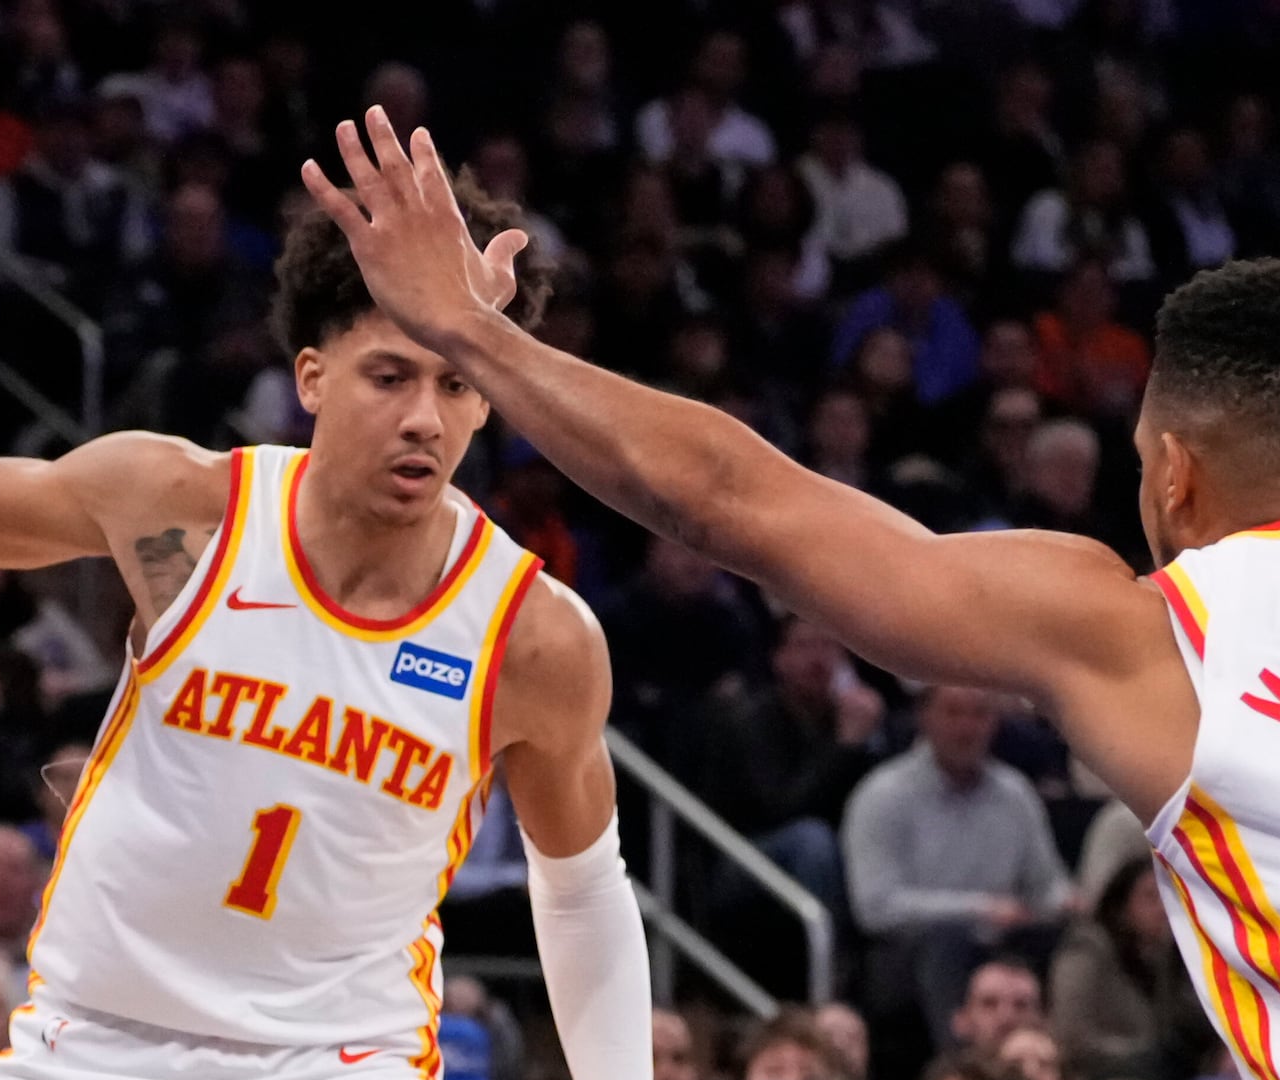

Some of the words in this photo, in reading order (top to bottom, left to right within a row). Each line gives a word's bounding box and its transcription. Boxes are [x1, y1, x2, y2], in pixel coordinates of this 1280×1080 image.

[395, 651, 466, 687] paze
[162, 667, 454, 811] ATLANTA
[223, 802, 302, 921] 1
